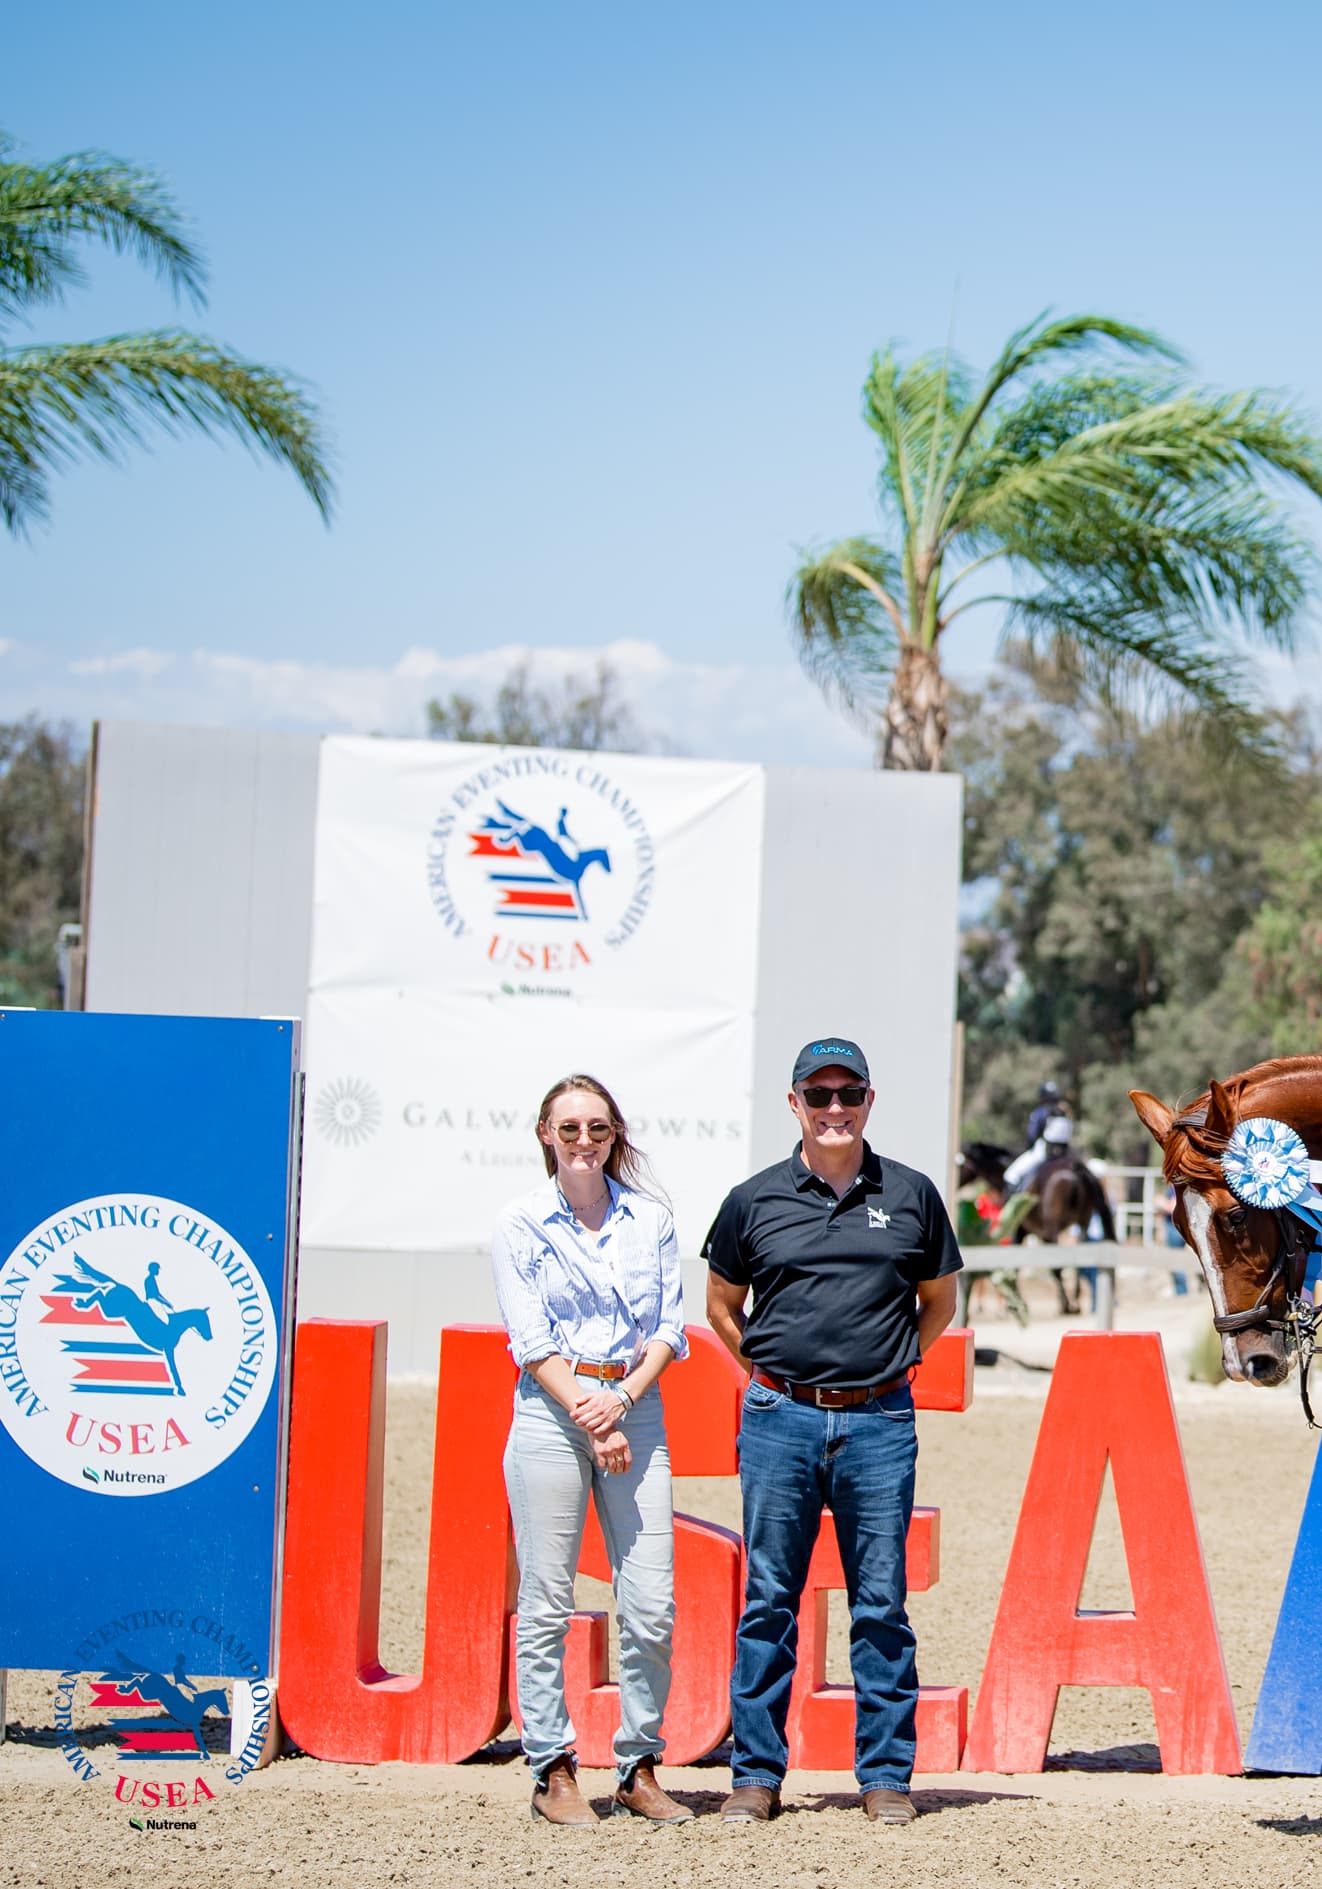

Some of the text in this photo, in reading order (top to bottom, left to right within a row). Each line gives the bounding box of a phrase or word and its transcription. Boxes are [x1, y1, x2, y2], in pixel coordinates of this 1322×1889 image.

[426, 755, 656, 951] AMERICAN EVENTING CHAMPIONSHIPS
[487, 934, 592, 972] USEA
[402, 1101, 743, 1140] GALWA OWNS
[23, 1204, 160, 1270] EVENTING
[168, 1213, 265, 1429] CHAMPIONSHIPS
[65, 1411, 192, 1456] USEA
[103, 1468, 166, 1485] Nutrena
